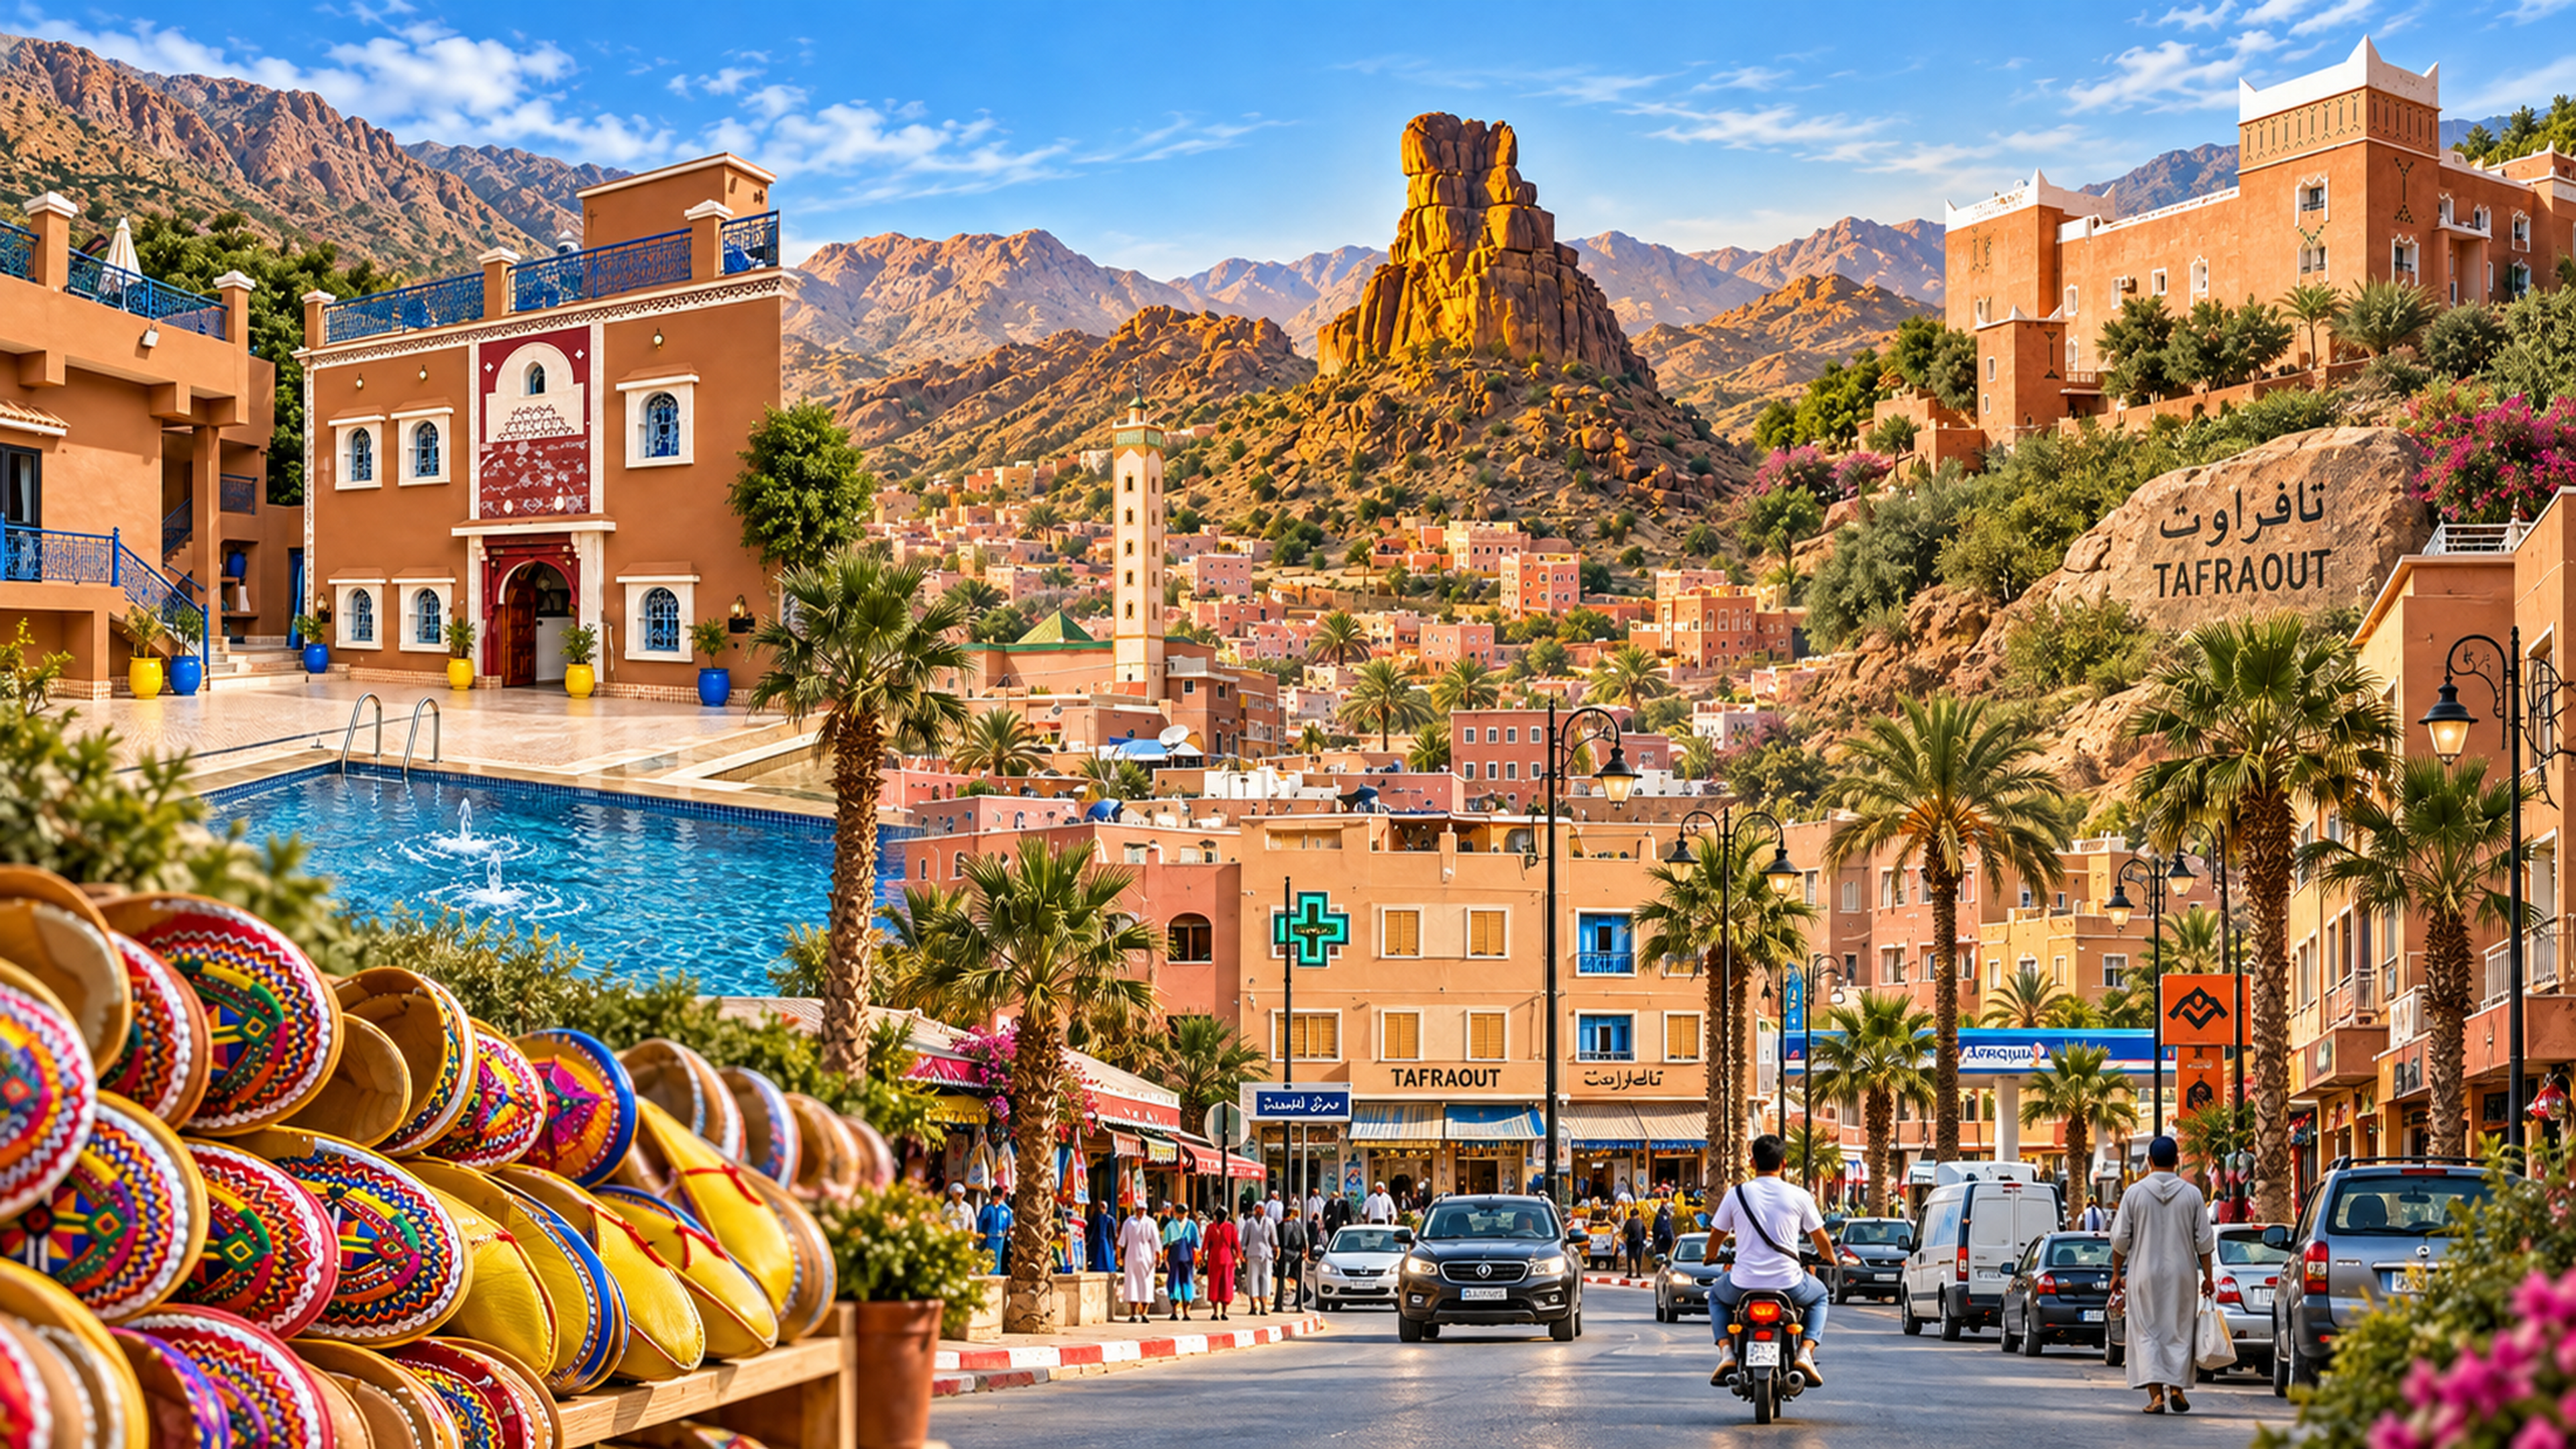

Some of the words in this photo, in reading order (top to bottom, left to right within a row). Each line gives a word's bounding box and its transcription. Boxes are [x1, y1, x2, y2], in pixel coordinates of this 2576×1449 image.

[2159, 480, 2326, 547] تافراوت
[2153, 548, 2332, 598] TAFRAOUT
[1391, 1069, 1501, 1087] TAFRAOUT
